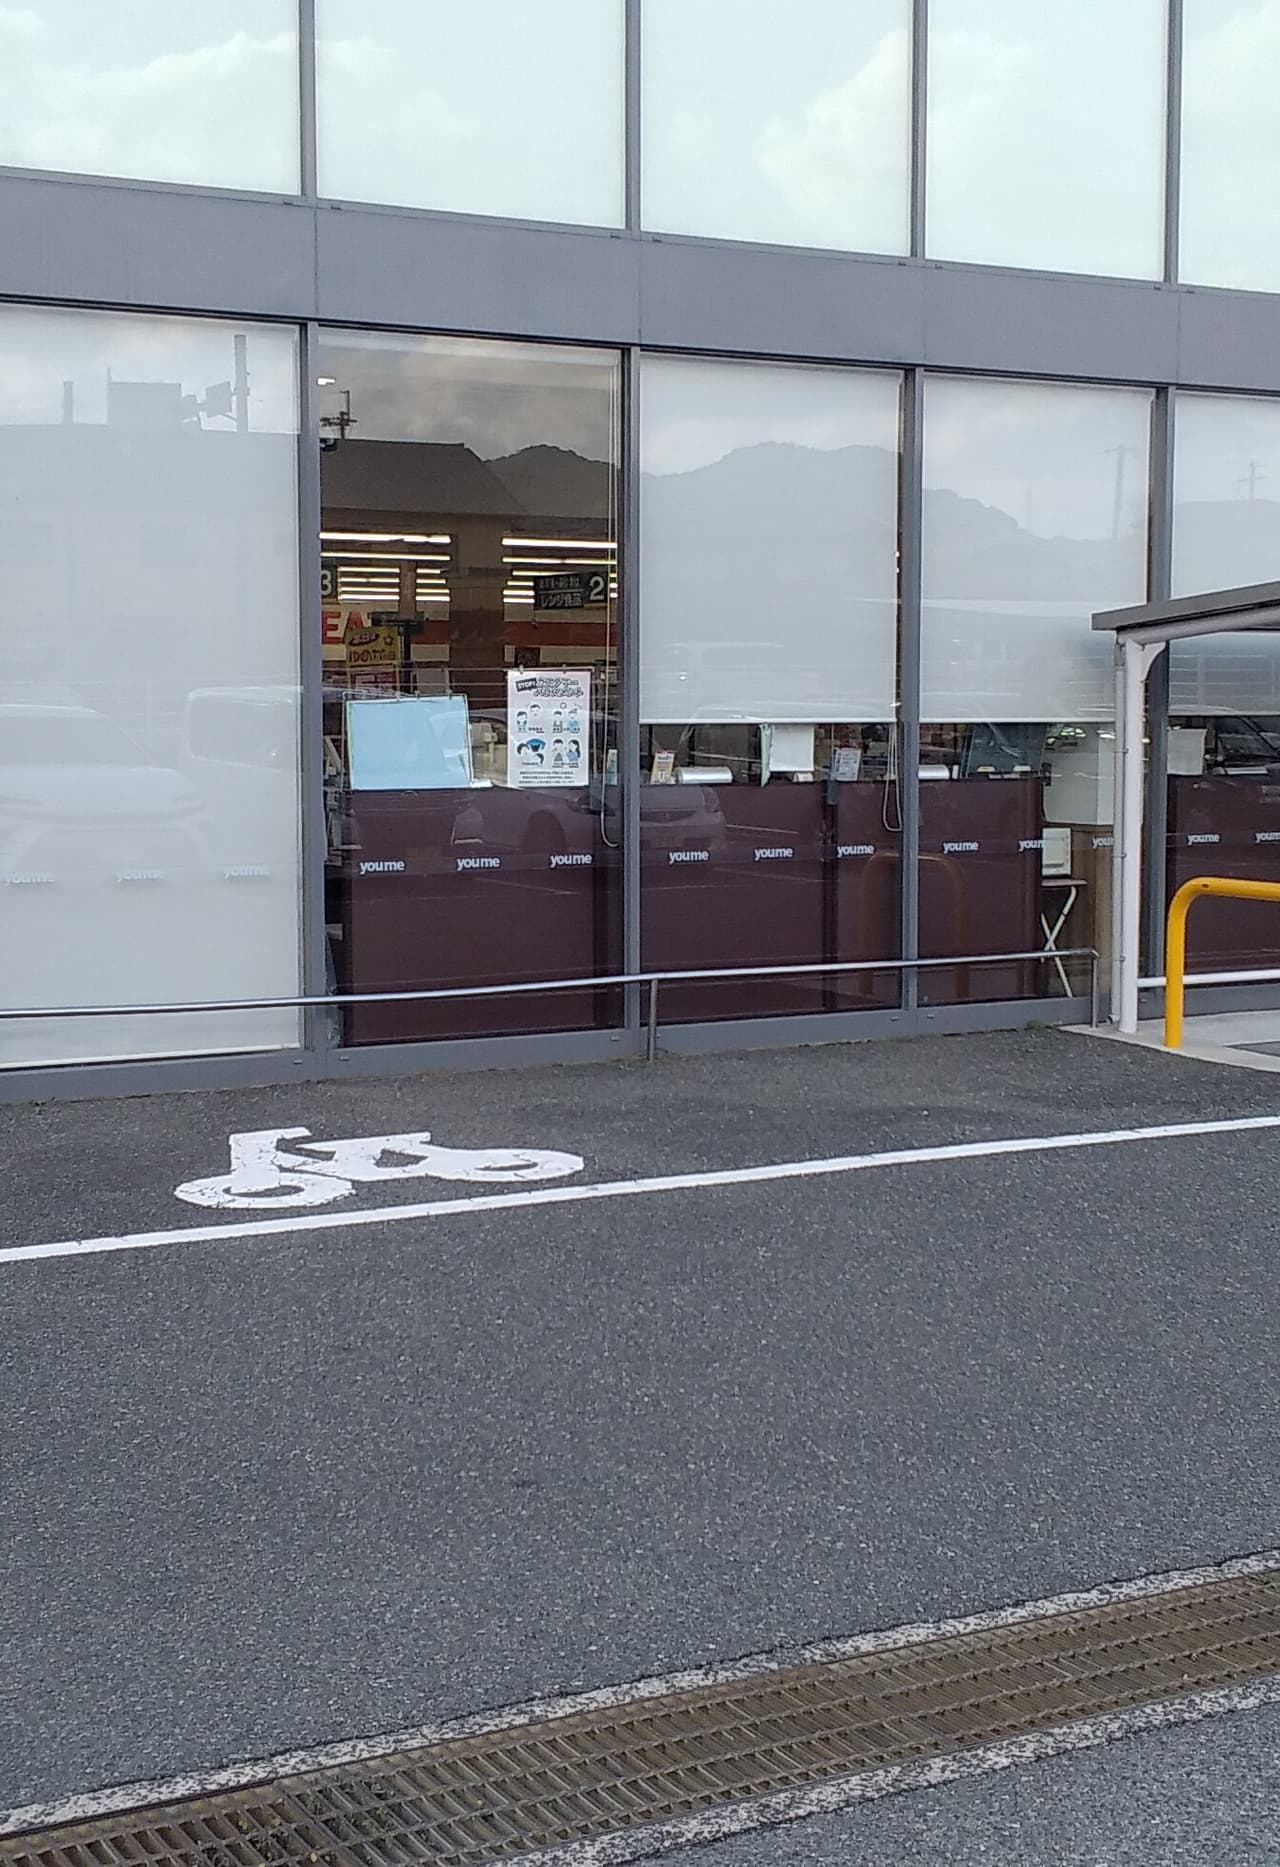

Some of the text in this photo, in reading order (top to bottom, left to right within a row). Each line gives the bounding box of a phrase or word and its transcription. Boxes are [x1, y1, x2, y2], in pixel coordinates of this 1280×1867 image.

[321, 570, 332, 596] 3
[588, 575, 605, 601] 2
[668, 843, 875, 864] youme youme youme
[942, 840, 979, 855] youme
[360, 851, 593, 876] youme youme youme
